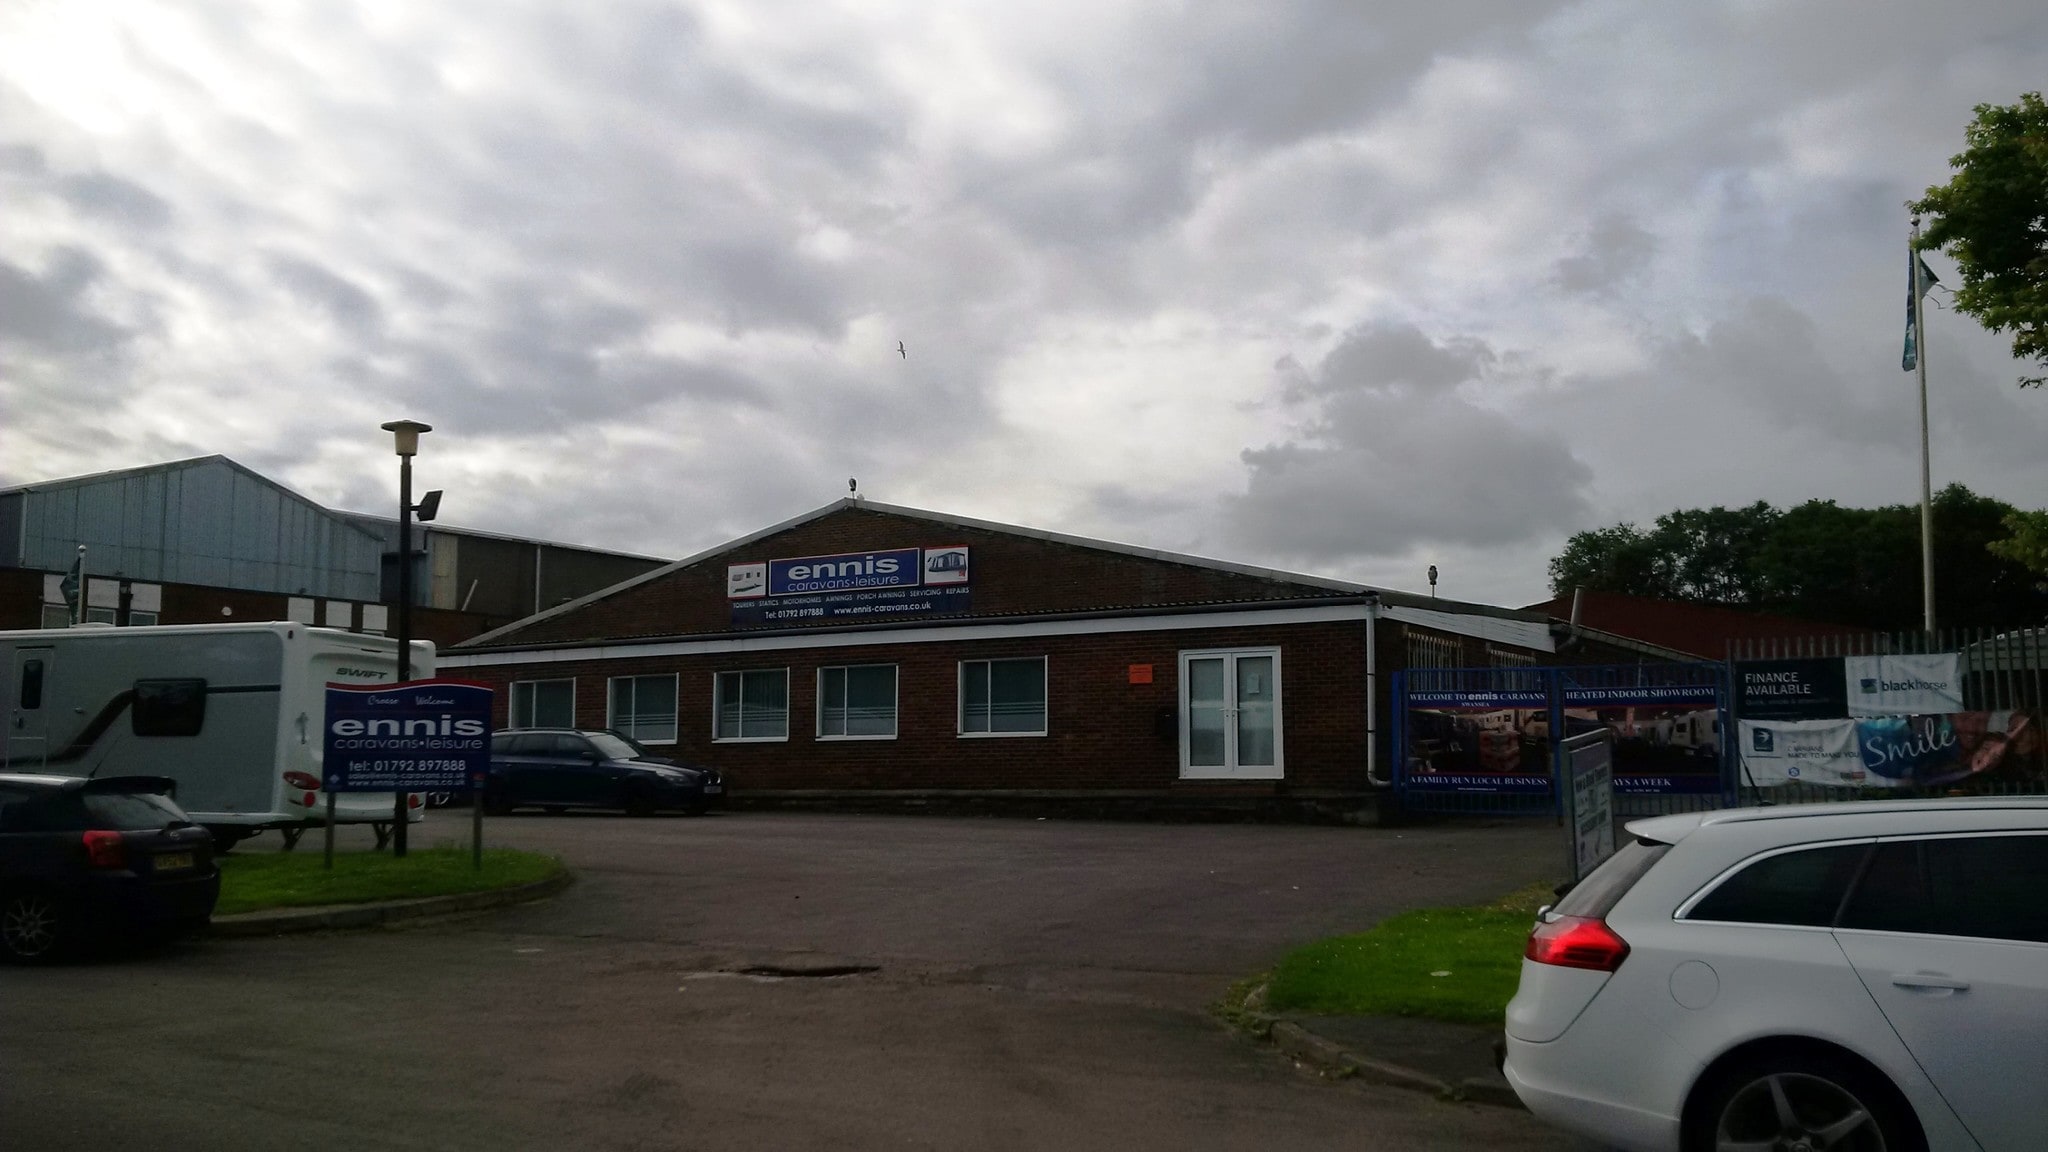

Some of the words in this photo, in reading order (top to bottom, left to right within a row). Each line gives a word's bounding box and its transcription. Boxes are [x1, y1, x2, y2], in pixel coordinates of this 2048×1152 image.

[787, 555, 900, 580] ennis
[909, 589, 941, 597] SERVICING
[946, 586, 971, 595] REPAIRS
[777, 609, 798, 618] 01792
[799, 607, 824, 617] 897888
[833, 601, 932, 616] www.ennis-caravans.co.uk
[336, 667, 388, 680] SWIFT
[1744, 671, 1800, 683] FINANCE
[1565, 690, 1606, 699] HEATED
[1607, 689, 1649, 699] INDOOR
[1650, 687, 1715, 698] SHOWROOM
[1745, 683, 1812, 695] AVAILABLE
[367, 695, 400, 706] Croeso
[414, 695, 457, 706] Welcome
[1409, 693, 1453, 701] WELCOME
[1455, 693, 1467, 701] TO
[1467, 691, 1498, 701] ennis
[1499, 692, 1546, 701] CARAVANS
[331, 714, 486, 737] ennis
[1865, 717, 1957, 768] Smile
[348, 760, 370, 772] tel:
[373, 760, 415, 772] 01792
[417, 760, 466, 772] 897888
[1417, 776, 1449, 784] FAMILY
[1451, 776, 1472, 785] RUN
[1473, 776, 1503, 785] LOCAL
[1504, 777, 1548, 786] BUSINESS
[1640, 777, 1673, 787] WEEK
